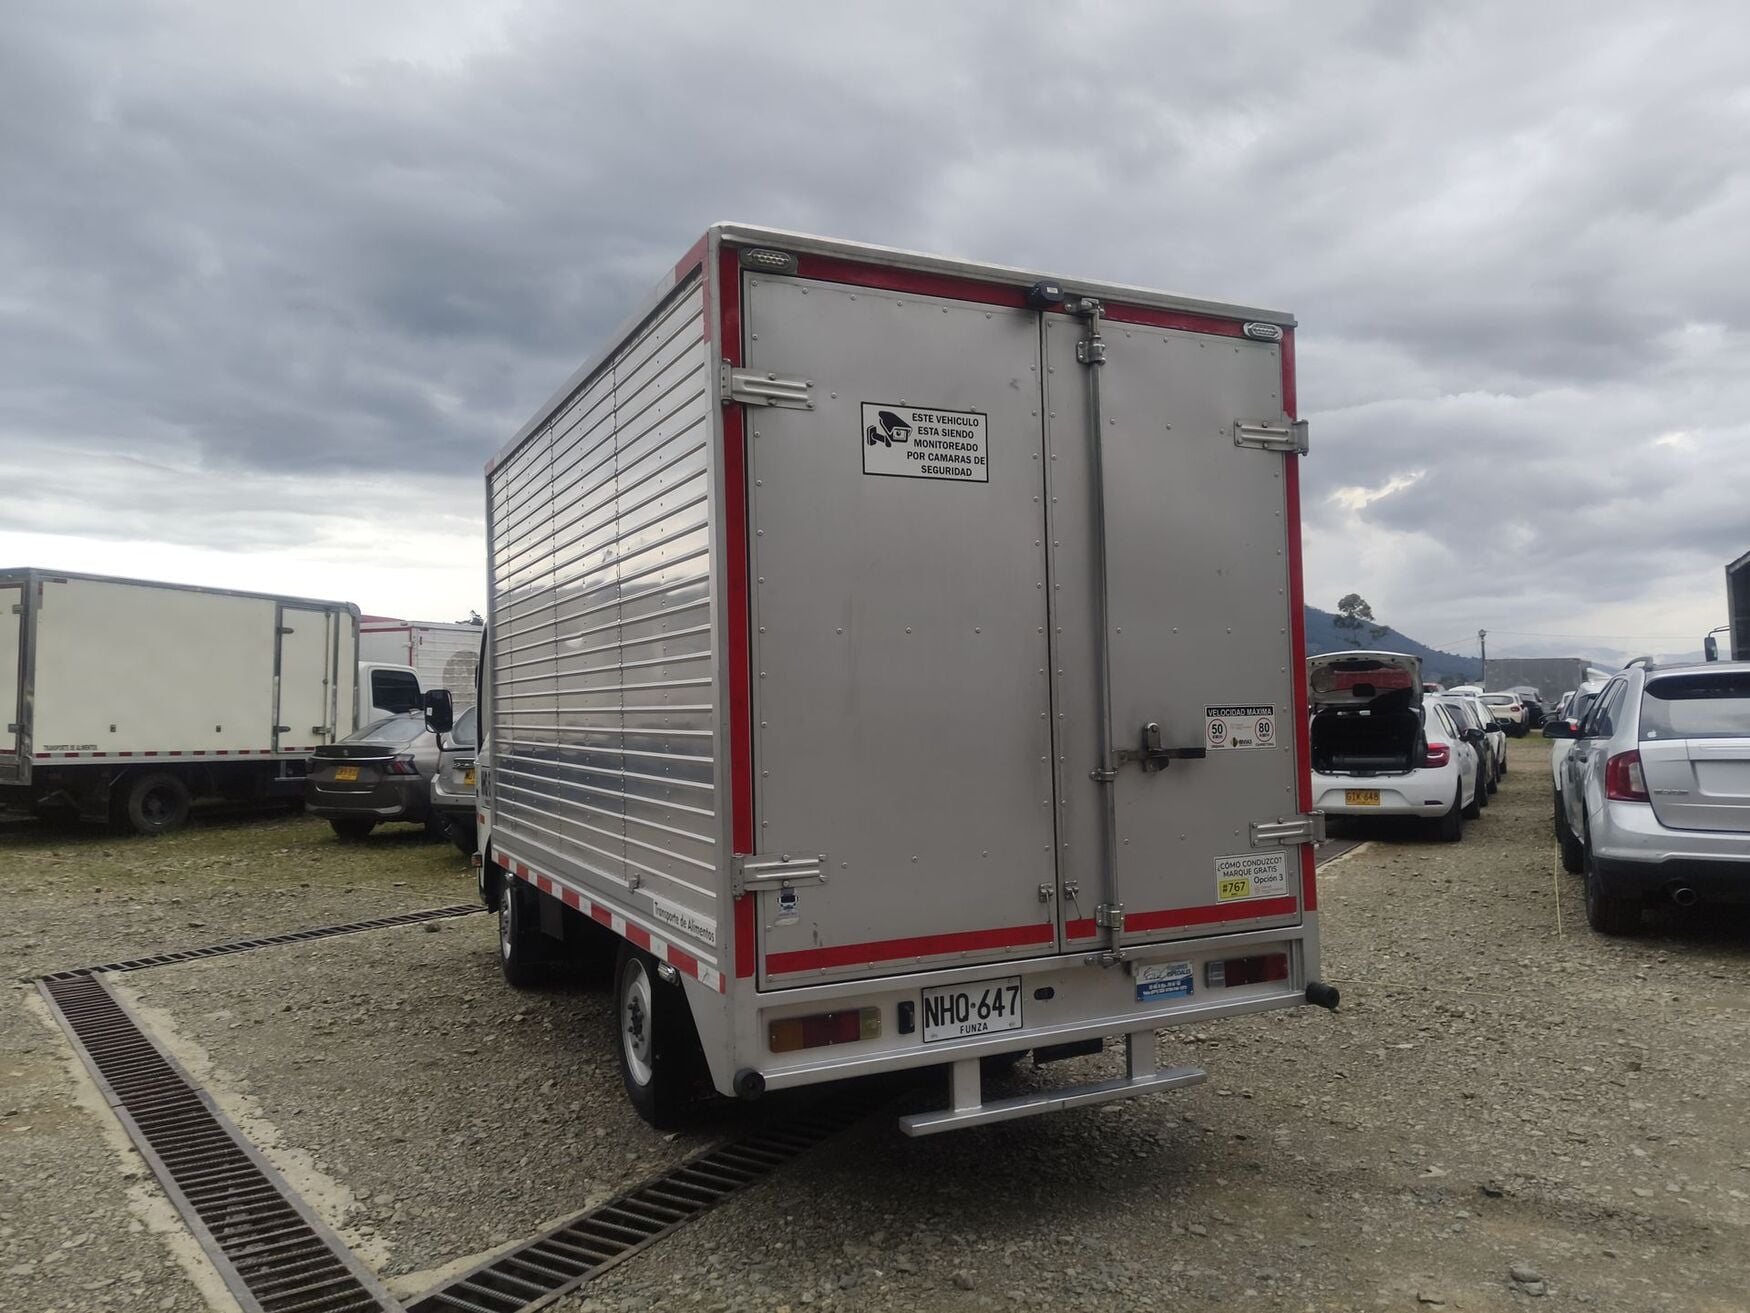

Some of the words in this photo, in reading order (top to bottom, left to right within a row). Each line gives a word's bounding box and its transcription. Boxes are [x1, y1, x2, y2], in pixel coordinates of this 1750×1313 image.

[912, 413, 934, 423] ESTE
[936, 415, 979, 427] VEHICULO
[918, 426, 939, 436] ESTA
[941, 428, 974, 439] SIENDO
[913, 439, 978, 452] MONITOREADO
[907, 451, 925, 460] POR
[928, 453, 972, 464] CAMARAS
[974, 456, 986, 465] DE
[921, 465, 972, 477] SEGURIDAD
[1207, 708, 1246, 717] VELOCIDAD
[1211, 724, 1223, 734] 50
[1258, 722, 1270, 733] 80
[1242, 857, 1282, 868] CONDUZCO?
[1223, 868, 1252, 877] MARQUE
[1253, 866, 1278, 875] GRATIS
[1253, 875, 1278, 885] Opción
[1222, 881, 1246, 893] #767
[654, 901, 680, 925] Transporte
[680, 913, 687, 929] de
[687, 918, 715, 943] Alimentos
[959, 1022, 989, 1035] FUNZA
